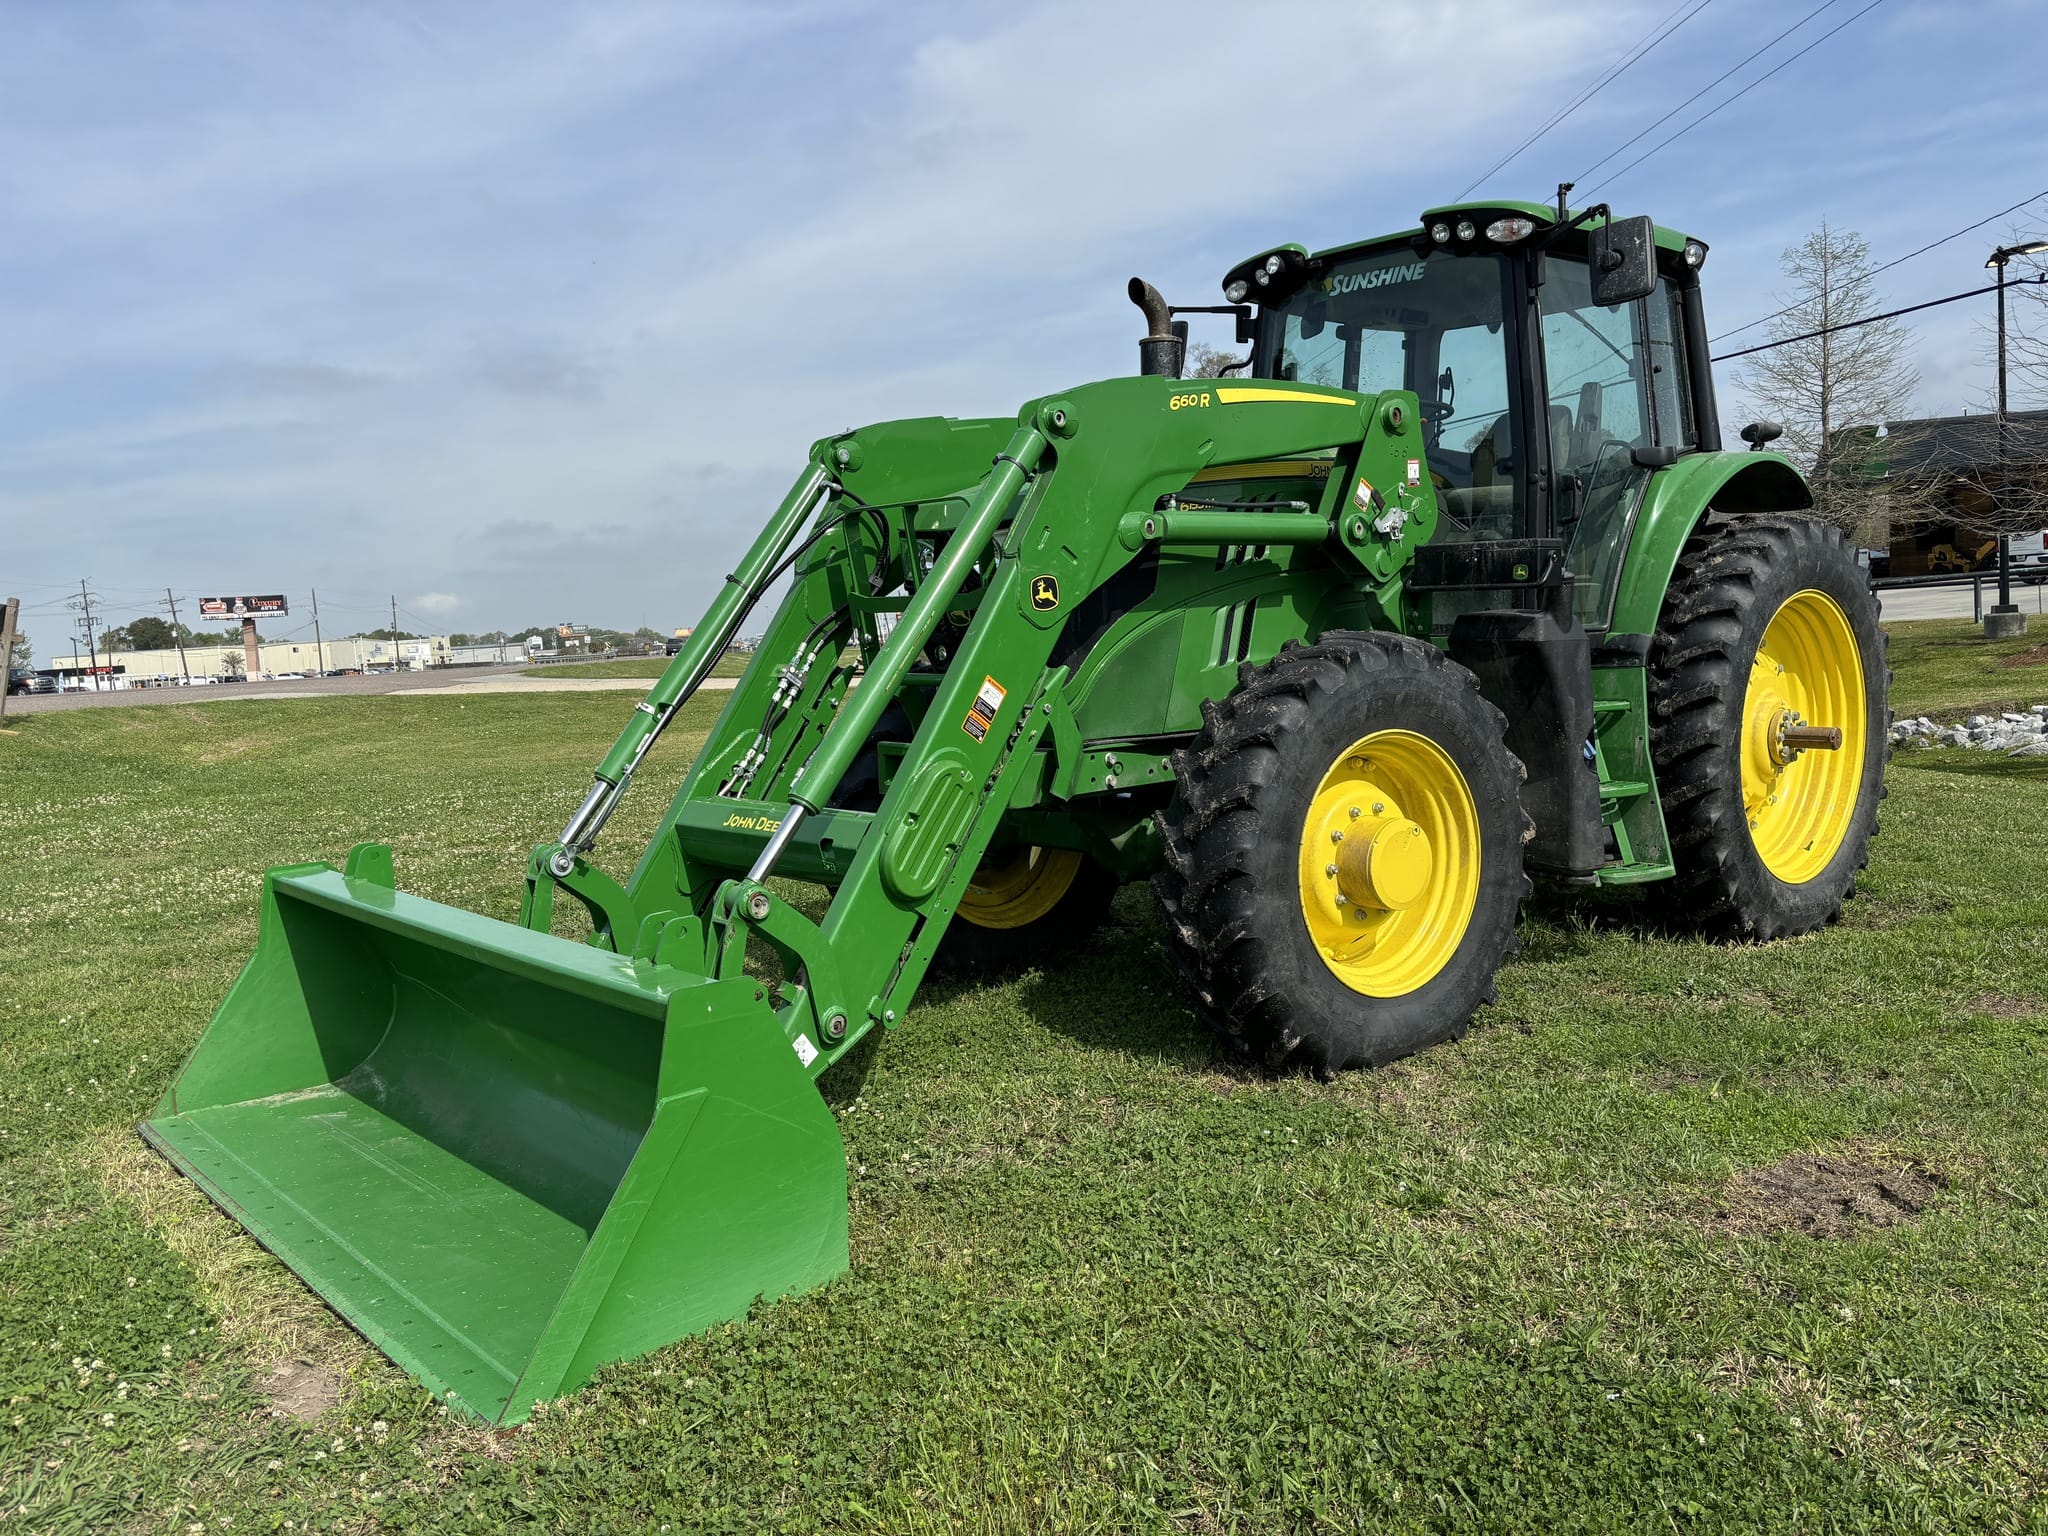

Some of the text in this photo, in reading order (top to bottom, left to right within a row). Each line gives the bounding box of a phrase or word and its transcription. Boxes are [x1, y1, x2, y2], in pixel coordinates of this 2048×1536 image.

[1329, 262, 1427, 296] SUNSHINE
[722, 813, 782, 832] JOHN DEE
